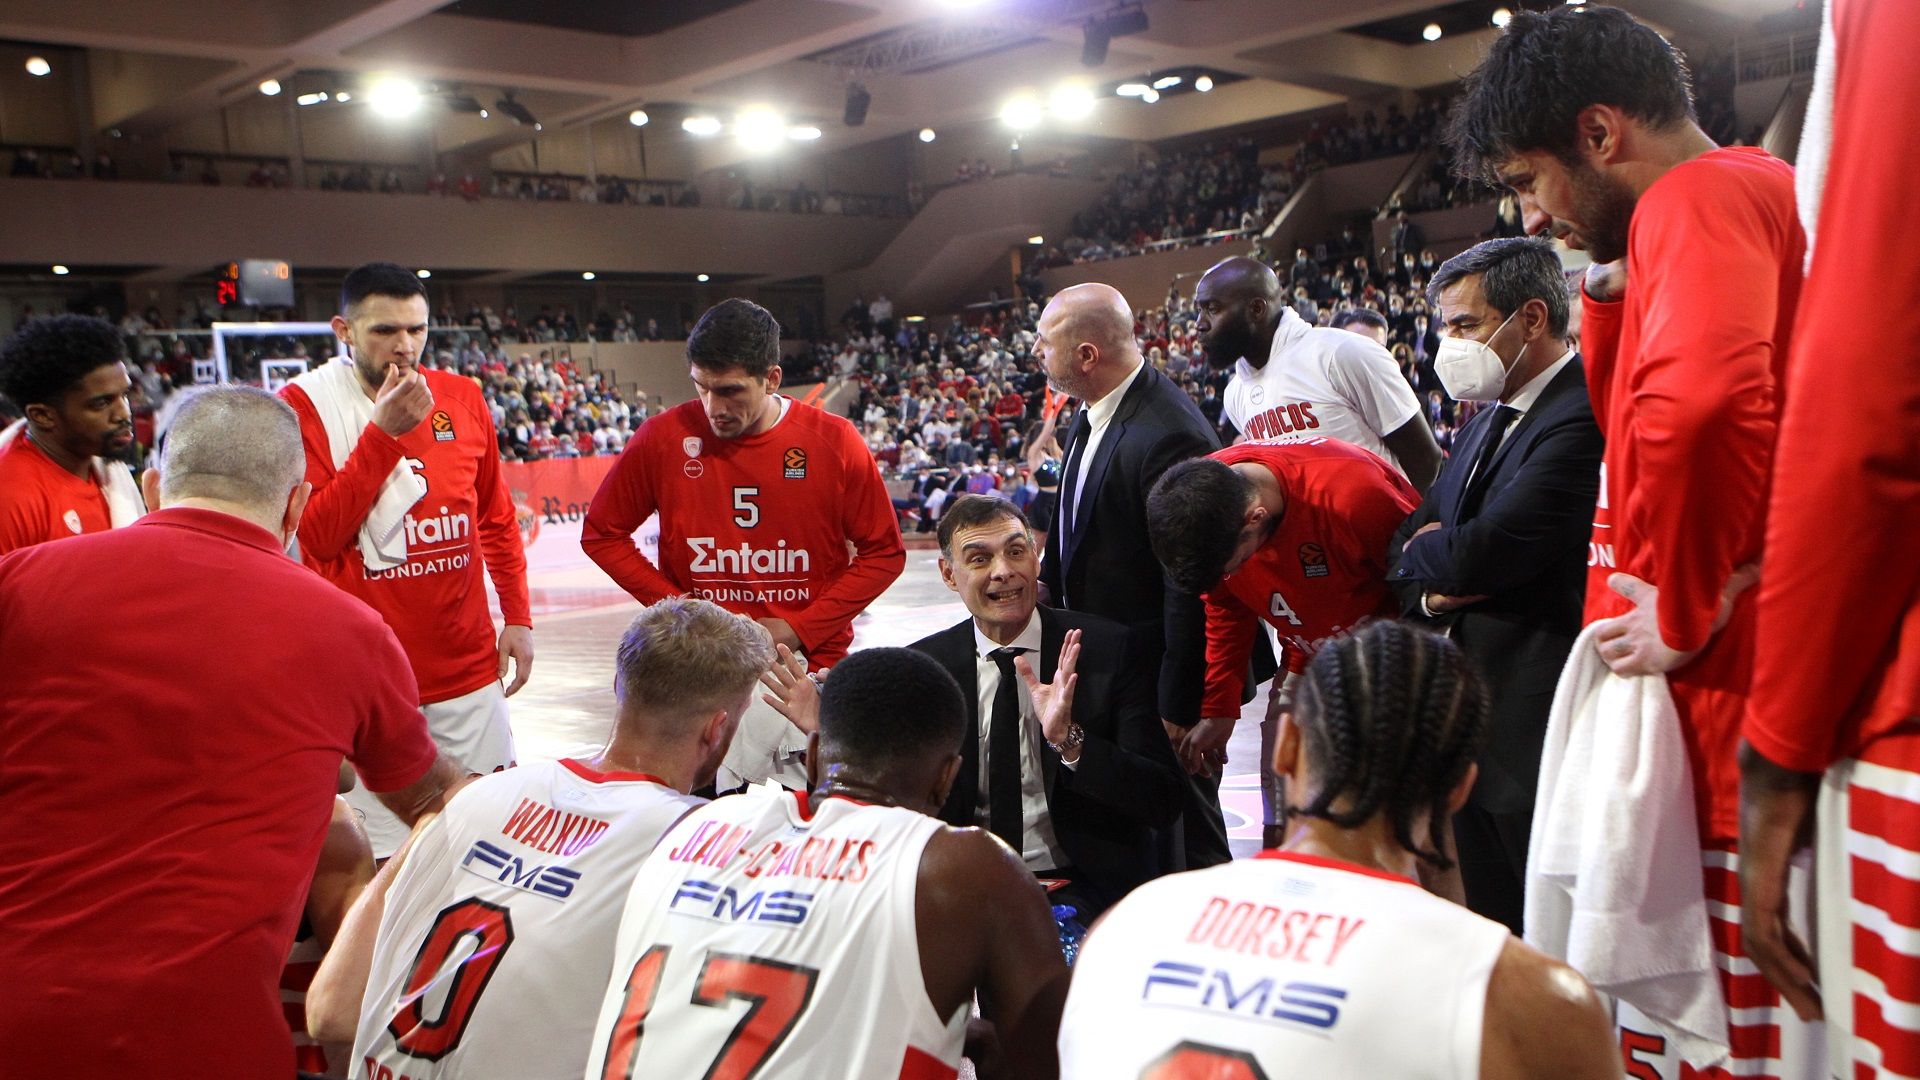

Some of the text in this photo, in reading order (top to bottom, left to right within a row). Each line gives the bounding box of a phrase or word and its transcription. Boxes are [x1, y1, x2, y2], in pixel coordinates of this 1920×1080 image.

[217, 281, 236, 304] 24
[404, 506, 470, 546] tain
[733, 486, 760, 530] 5
[1270, 592, 1303, 626] 4
[501, 796, 610, 858] WALKUP
[462, 838, 582, 899] FMS
[669, 879, 815, 925] FMS
[1185, 896, 1366, 967] DORSEY
[386, 896, 516, 1064] 0
[1141, 960, 1349, 1030] FMS
[601, 943, 821, 1080] 17
